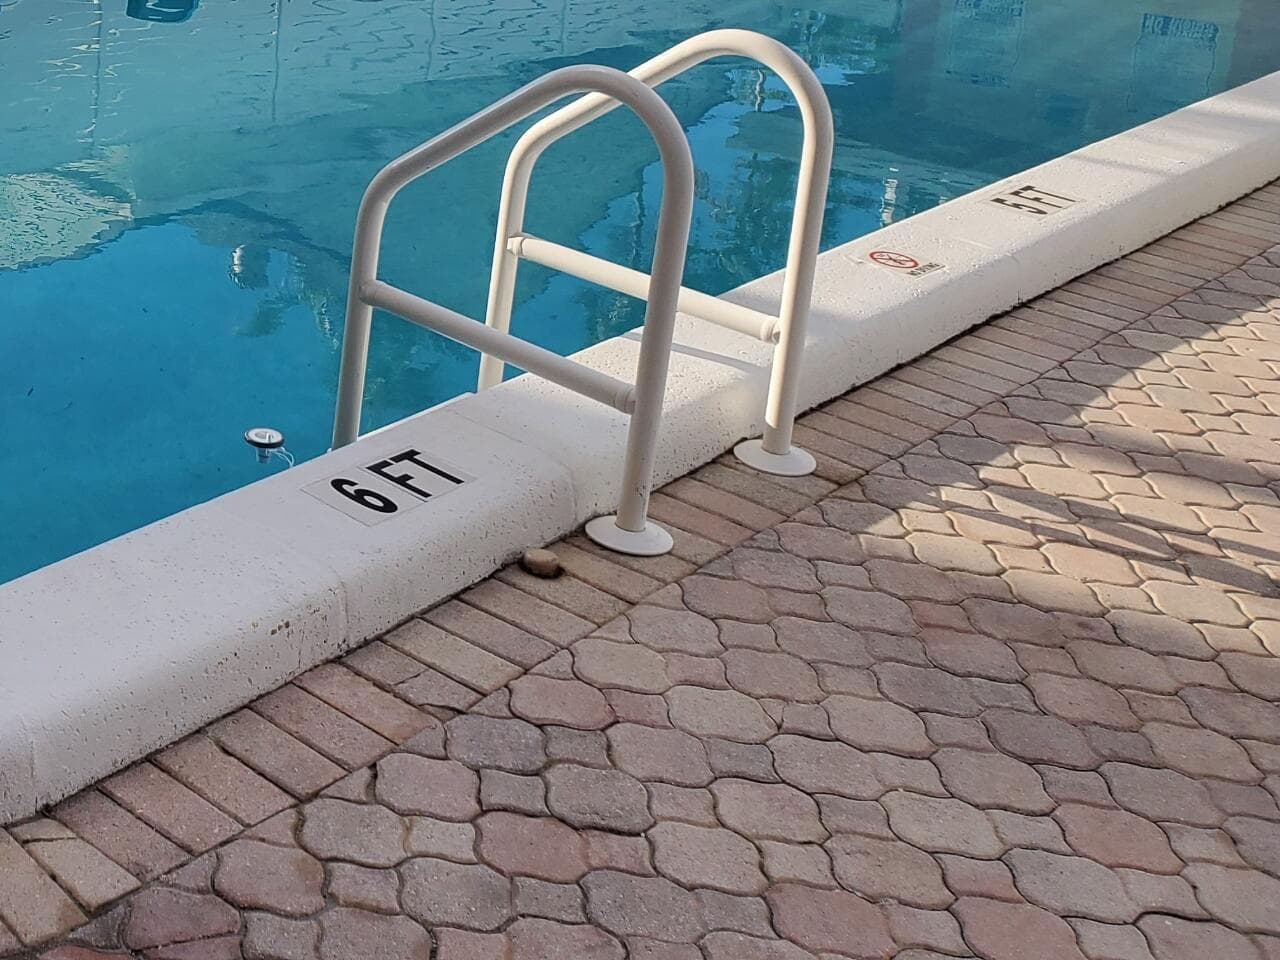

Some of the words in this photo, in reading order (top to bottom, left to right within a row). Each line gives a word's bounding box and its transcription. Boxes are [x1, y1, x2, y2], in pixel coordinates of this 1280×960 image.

[990, 197, 1048, 215] 5
[1008, 185, 1077, 209] FT
[330, 478, 398, 514] 6
[365, 449, 465, 498] FT
